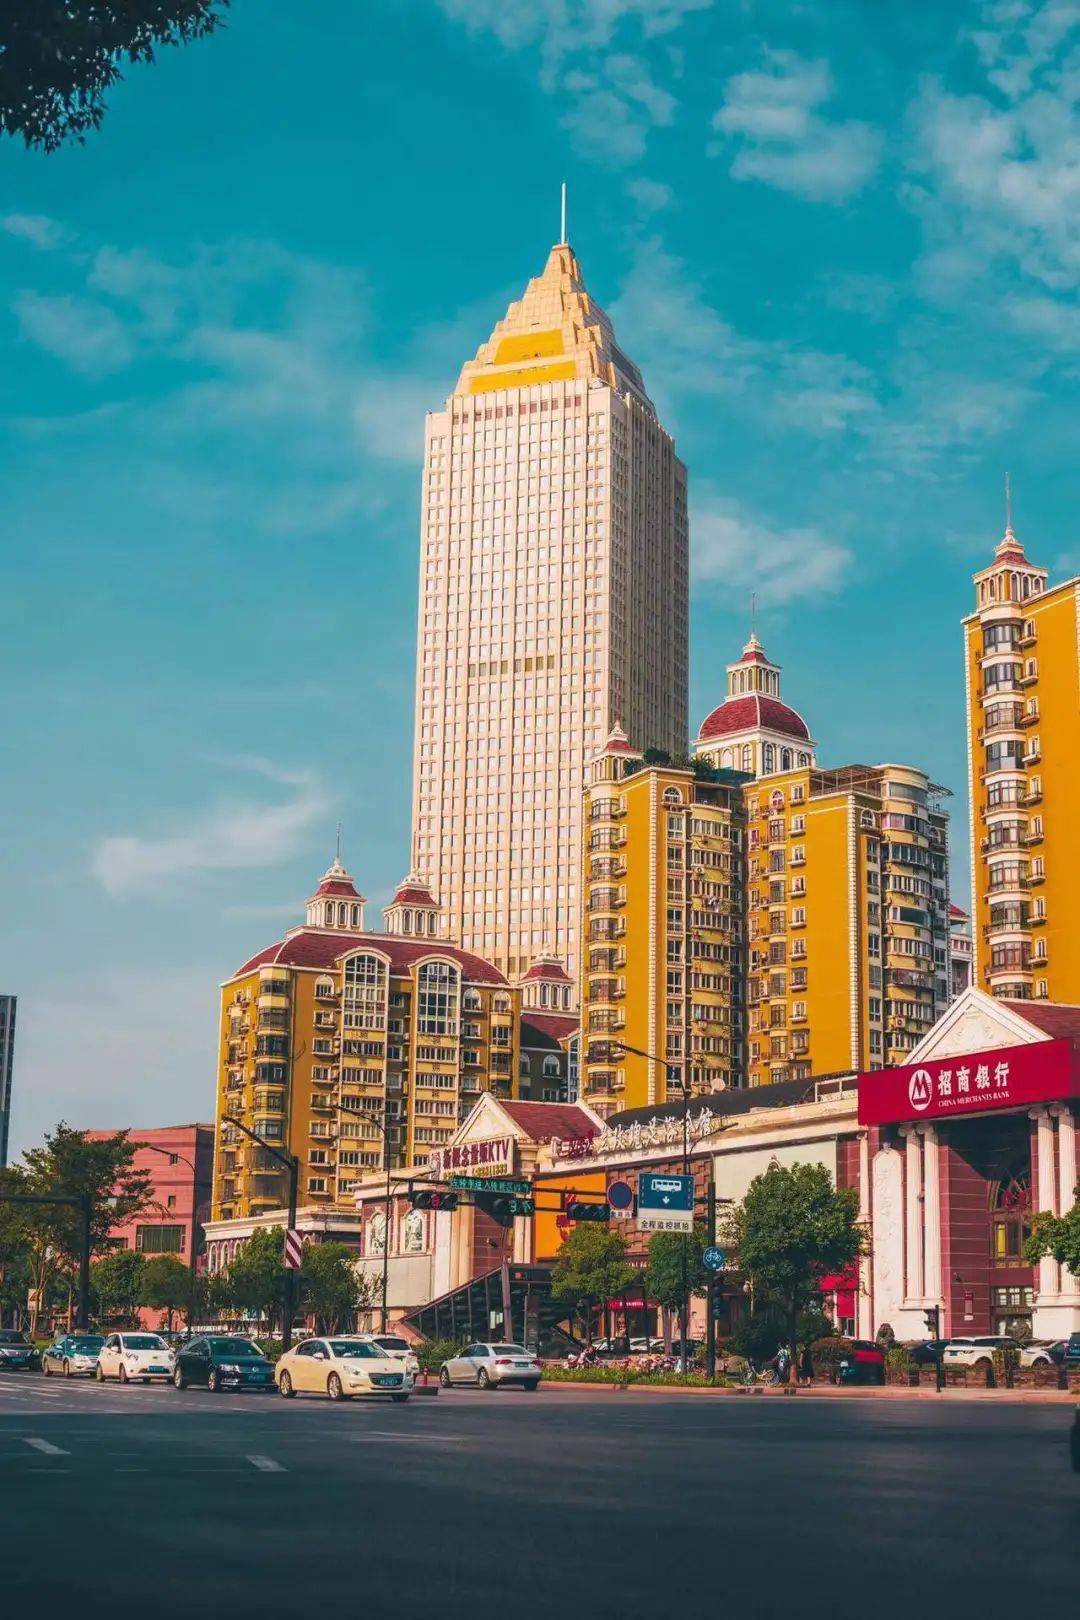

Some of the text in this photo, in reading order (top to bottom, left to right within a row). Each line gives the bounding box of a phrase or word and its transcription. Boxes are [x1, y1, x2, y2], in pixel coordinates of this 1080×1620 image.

[938, 1061, 1009, 1096] 招商银行
[938, 1091, 1010, 1108] CHINA MERCHANTS BANK
